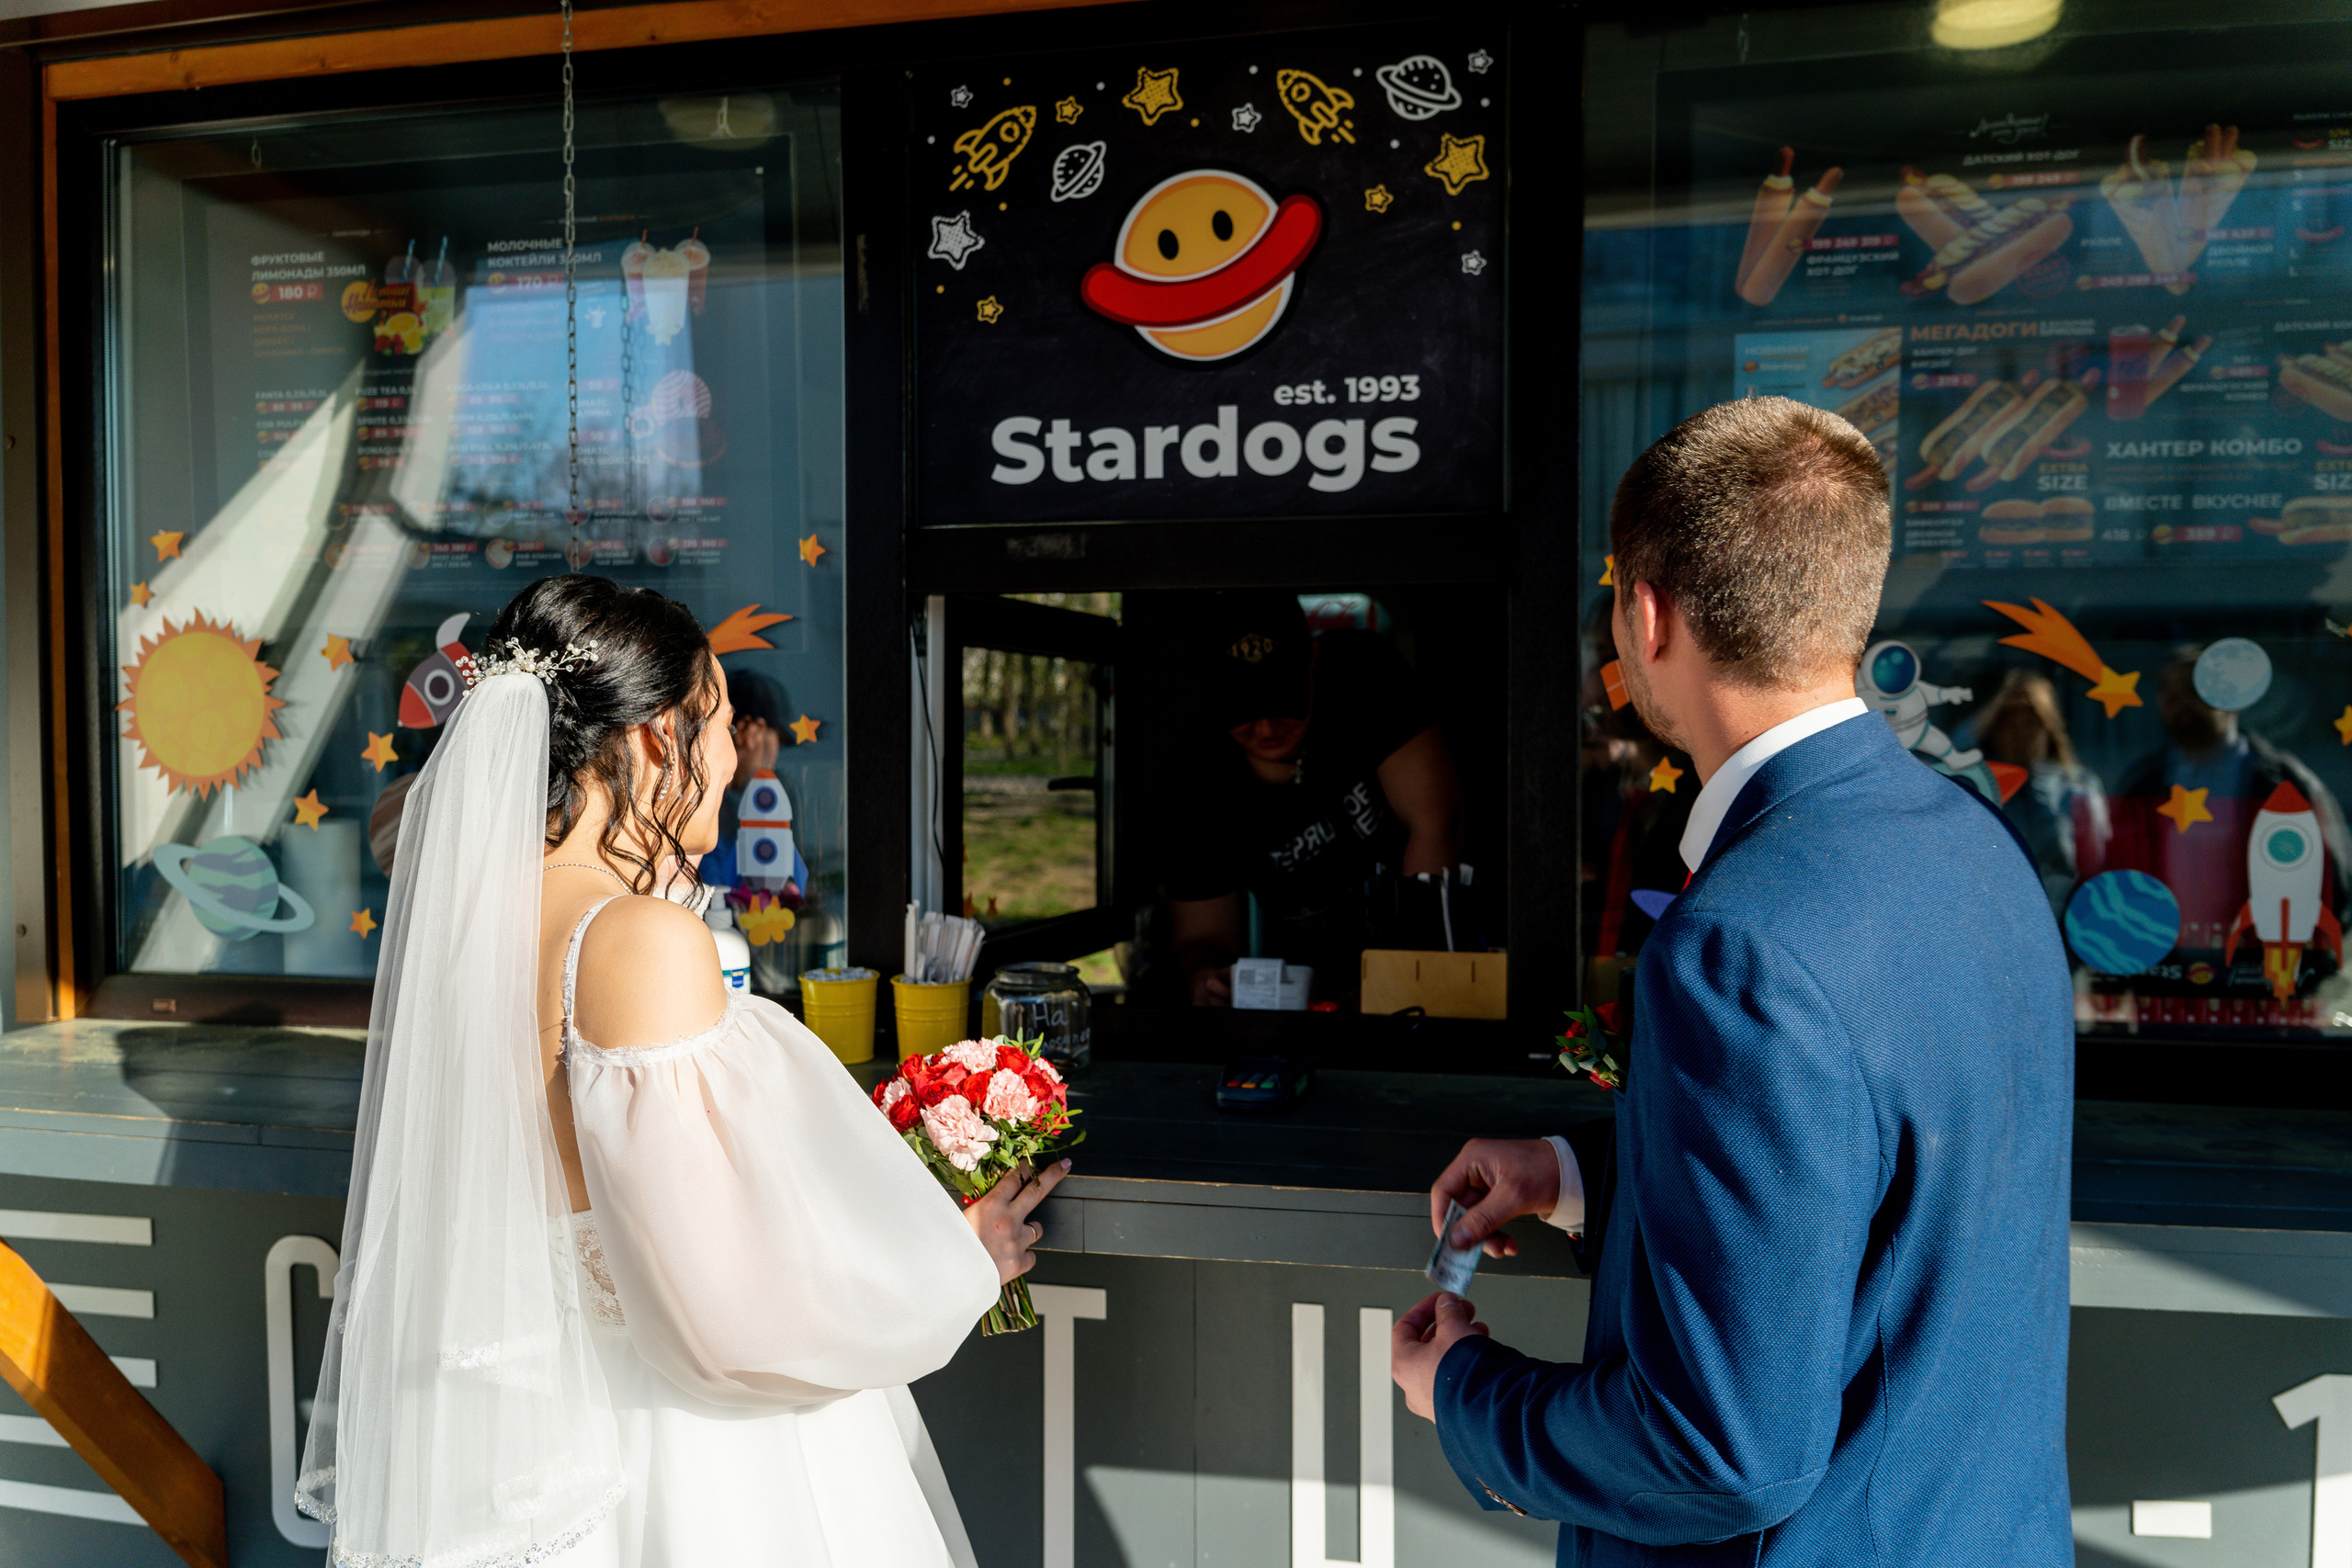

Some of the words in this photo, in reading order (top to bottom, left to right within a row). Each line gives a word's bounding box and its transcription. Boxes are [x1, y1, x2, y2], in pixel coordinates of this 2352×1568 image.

[487, 237, 564, 253] МОЛОЧНЫЕ
[250, 251, 325, 266] ФРУКТОВЫЕ
[487, 254, 557, 268] КОКТЕЙЛИ
[559, 251, 603, 265] 30МЛ
[250, 266, 325, 282] ЛИМОНАДЫ
[277, 284, 304, 300] 180
[1910, 321, 2038, 343] МЕГАДОГИ
[379, 386, 399, 396] TEA
[1273, 378, 1336, 406] est.
[1344, 375, 1421, 403] 1993
[990, 404, 1421, 493] Stardogs
[2105, 439, 2203, 459] ХАНТЕР
[2210, 436, 2302, 457] КОМБО
[2314, 460, 2352, 472] EXTR
[2037, 475, 2089, 492] SIZE
[2313, 472, 2352, 492] SIZ
[2103, 493, 2184, 512] ВМЕСТЕ
